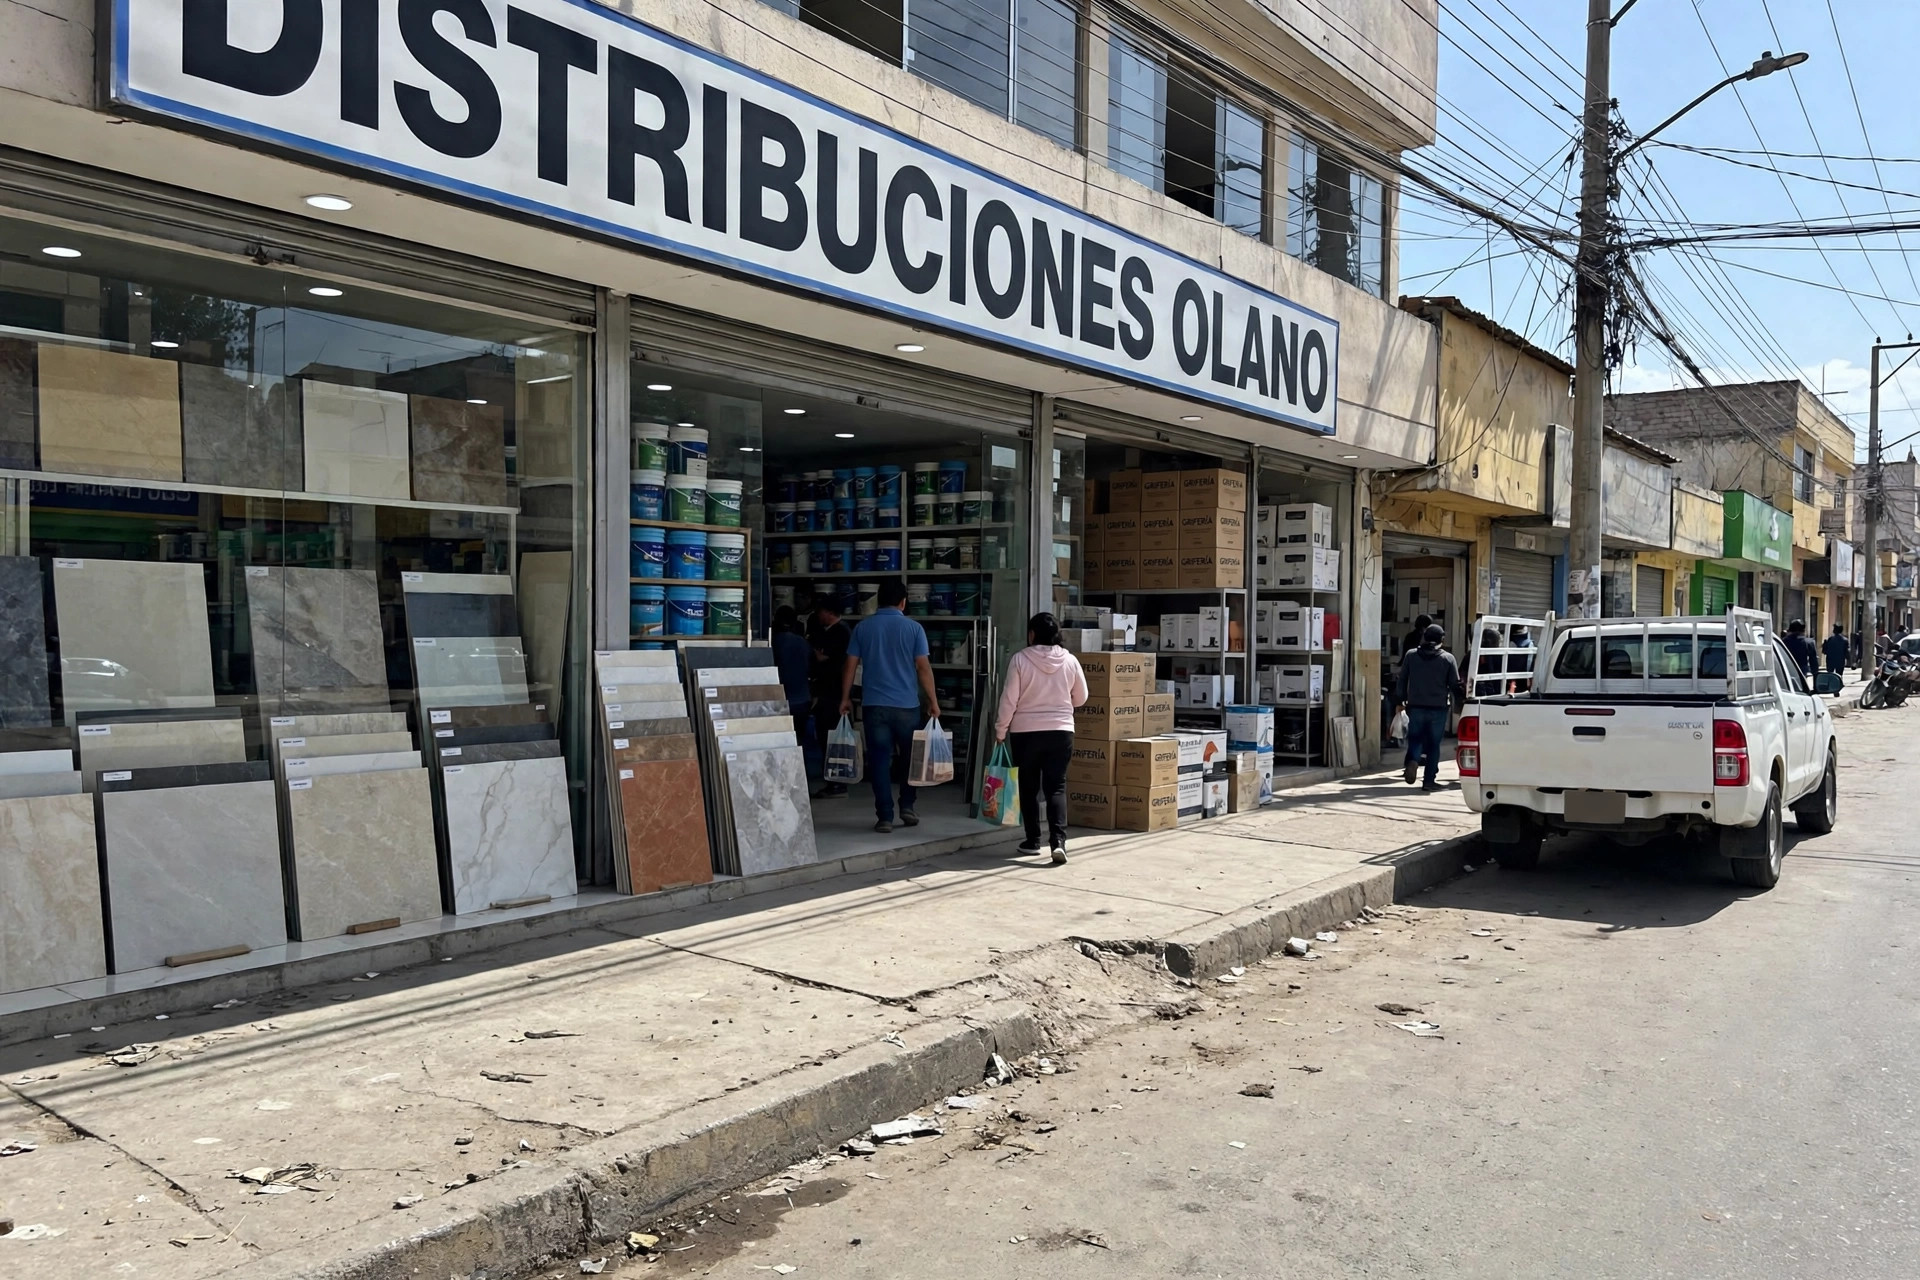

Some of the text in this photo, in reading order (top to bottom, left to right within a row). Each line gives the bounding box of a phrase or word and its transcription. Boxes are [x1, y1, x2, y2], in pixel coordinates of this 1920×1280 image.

[1172, 277, 1328, 413] OLANO
[1115, 662, 1141, 674] GRIFERÍA
[1113, 704, 1140, 715] GRIFERÍA
[1069, 792, 1108, 804] GRIFERÍA
